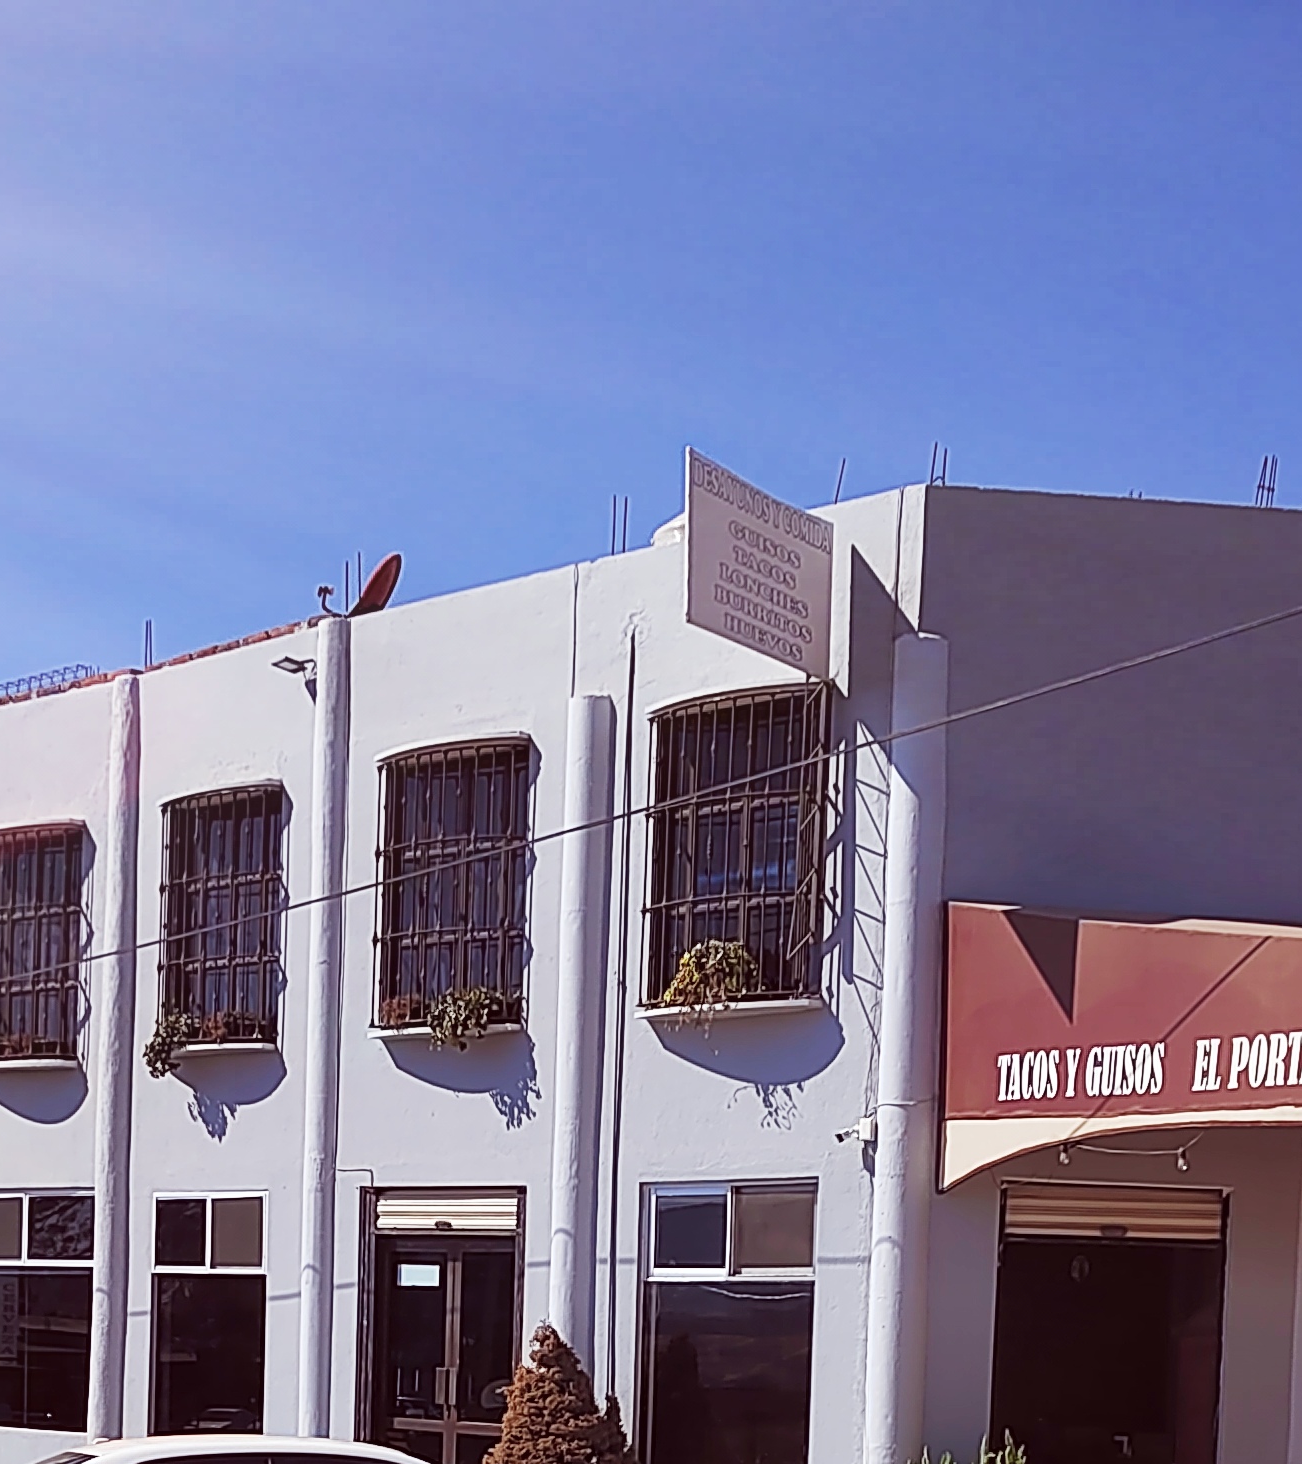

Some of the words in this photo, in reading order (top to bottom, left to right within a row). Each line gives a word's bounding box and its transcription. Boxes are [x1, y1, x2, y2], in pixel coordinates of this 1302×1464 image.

[692, 456, 770, 524] DESAYUNOS
[770, 498, 780, 529] Y
[782, 507, 831, 555] COMIDA
[728, 520, 801, 569] GUISOS
[733, 545, 796, 590] TACOS
[714, 584, 813, 644] BURRITOS
[719, 562, 809, 619] LONCHES
[724, 612, 803, 662] HUEVOS
[997, 1049, 1060, 1101] TACOS
[1065, 1048, 1081, 1098] Y
[1085, 1041, 1165, 1097] GUISOS
[1191, 1038, 1221, 1092] EL
